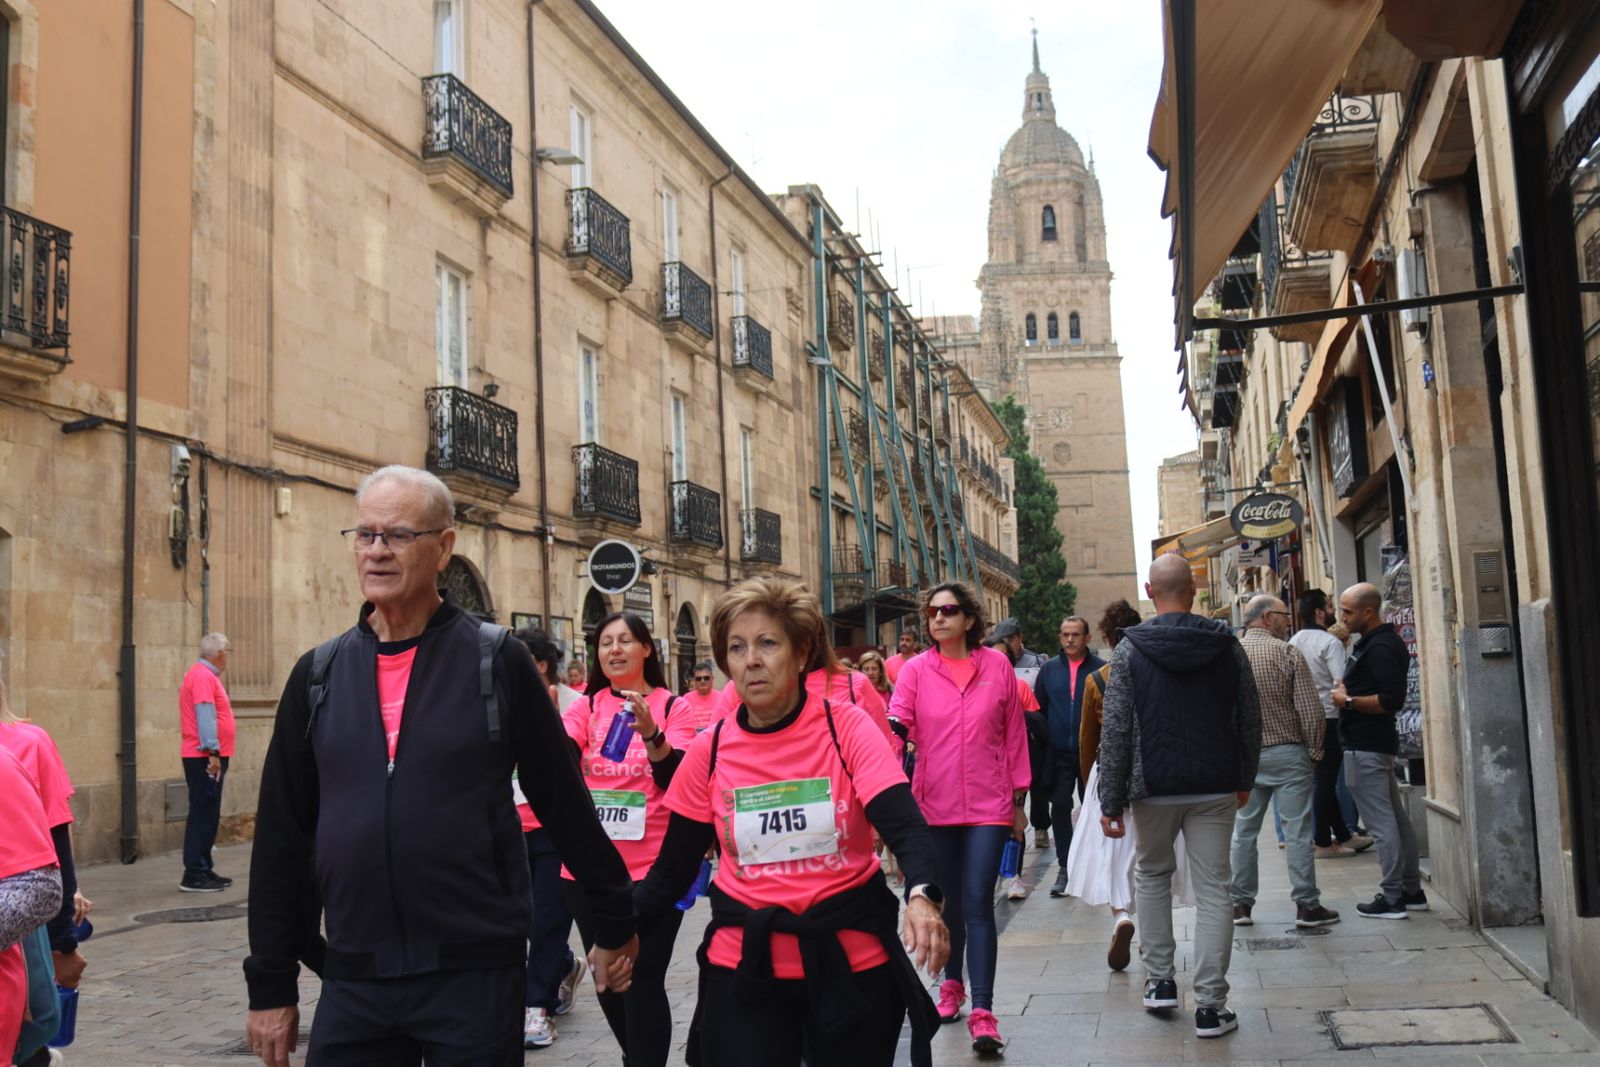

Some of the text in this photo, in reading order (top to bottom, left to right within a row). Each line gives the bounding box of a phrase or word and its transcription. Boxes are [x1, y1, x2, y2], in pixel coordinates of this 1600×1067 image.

[1239, 500, 1293, 522] Coca-Cola
[591, 762, 654, 777] cance
[597, 807, 628, 822] 9776
[758, 808, 807, 835] 7415
